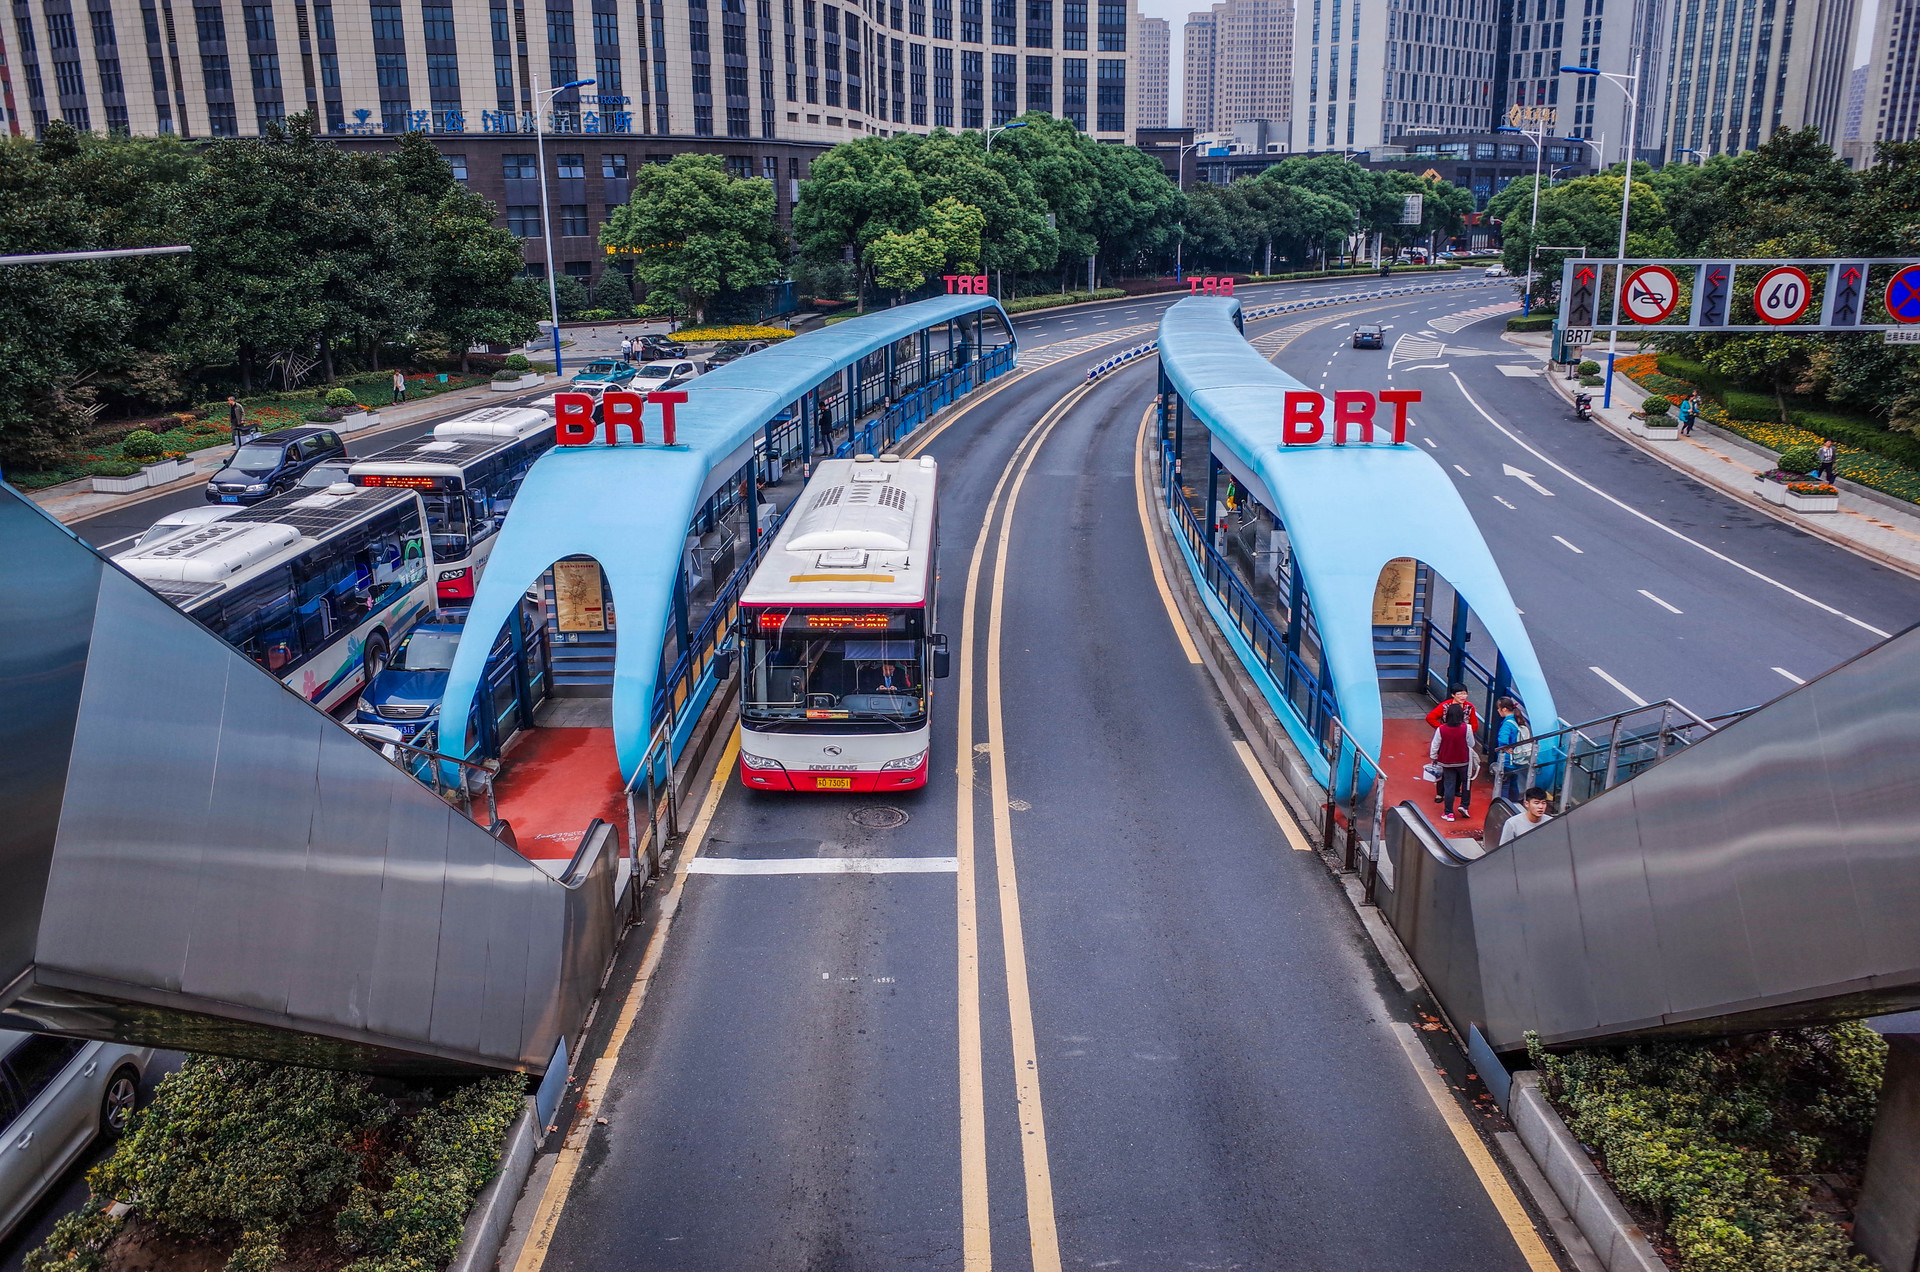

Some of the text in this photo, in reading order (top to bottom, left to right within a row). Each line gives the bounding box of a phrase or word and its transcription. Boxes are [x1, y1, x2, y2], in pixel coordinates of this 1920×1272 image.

[1767, 283, 1799, 309] 60
[1566, 329, 1592, 343] BRT
[554, 391, 689, 445] BRT
[1282, 390, 1422, 444] BRT
